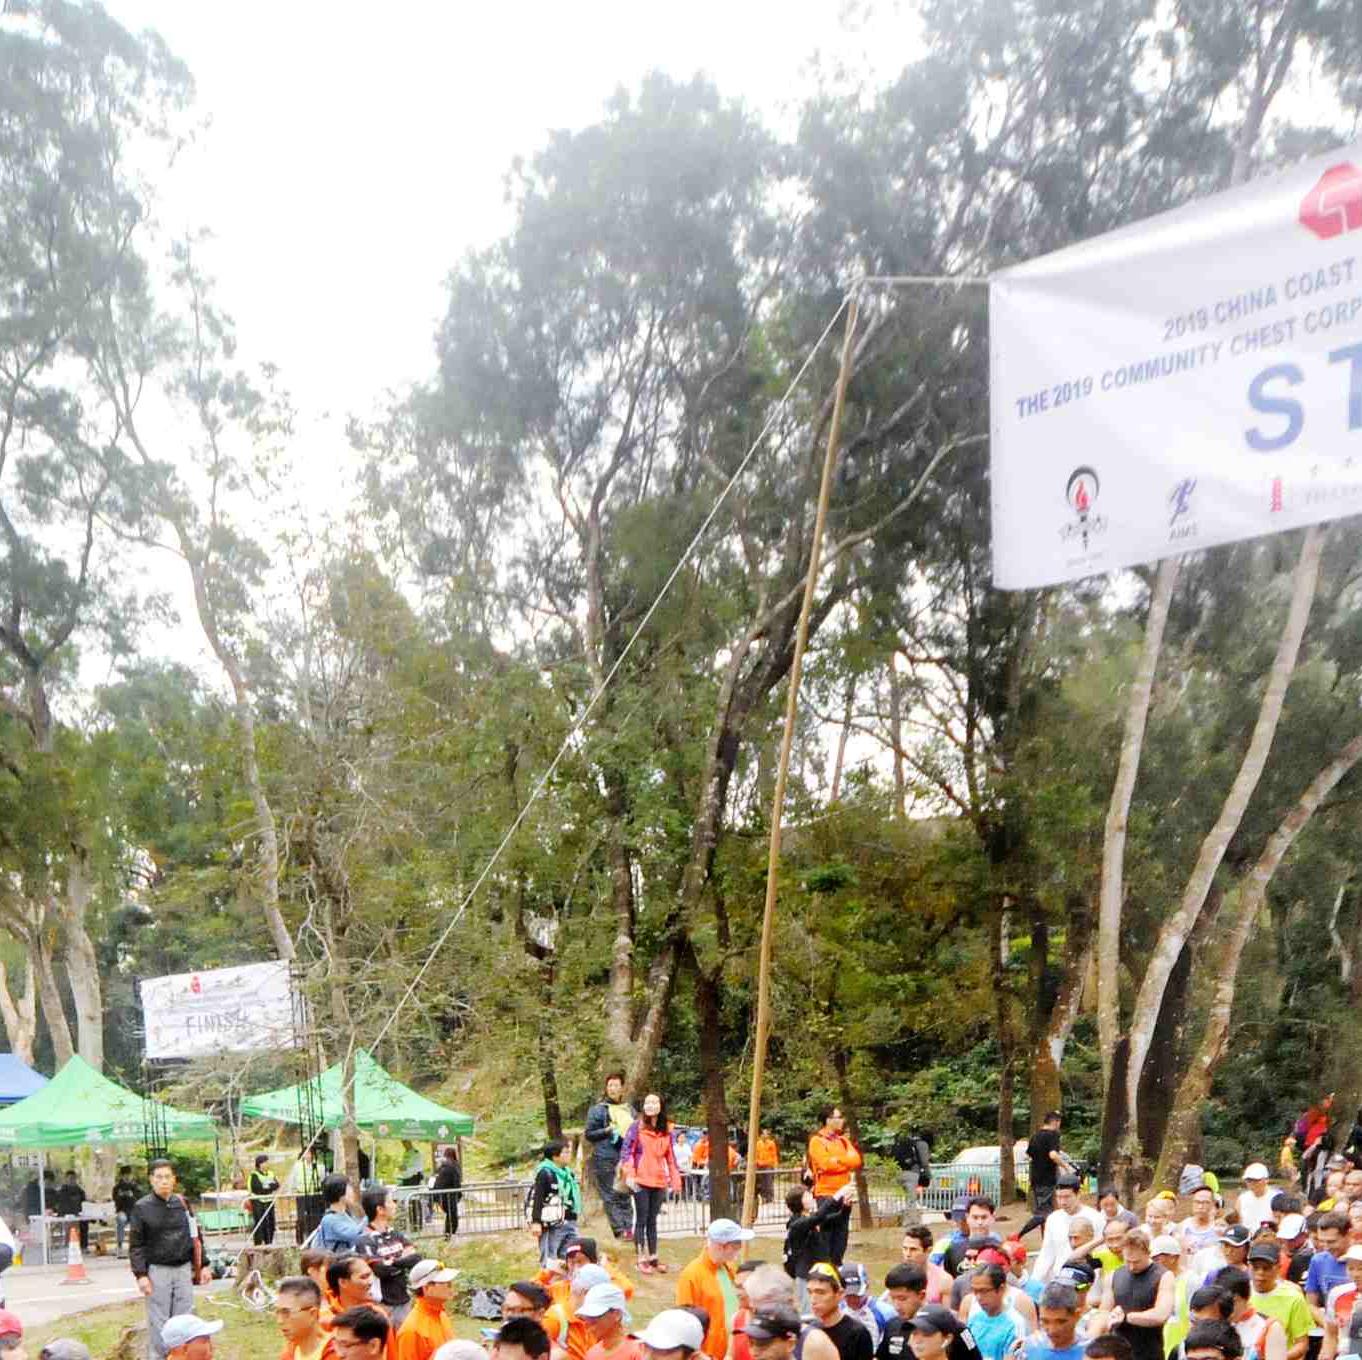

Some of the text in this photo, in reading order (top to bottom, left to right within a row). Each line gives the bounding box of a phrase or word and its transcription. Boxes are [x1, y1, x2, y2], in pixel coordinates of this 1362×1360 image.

[1164, 309, 1211, 341] 2019
[1214, 286, 1279, 332] CHINA
[1284, 257, 1355, 300] COAST
[1016, 392, 1050, 419] THE
[1053, 376, 1094, 408] 2019
[1100, 341, 1225, 393] COMMUNITY
[1230, 320, 1296, 357] CHEST
[185, 1008, 250, 1038] FINISH
